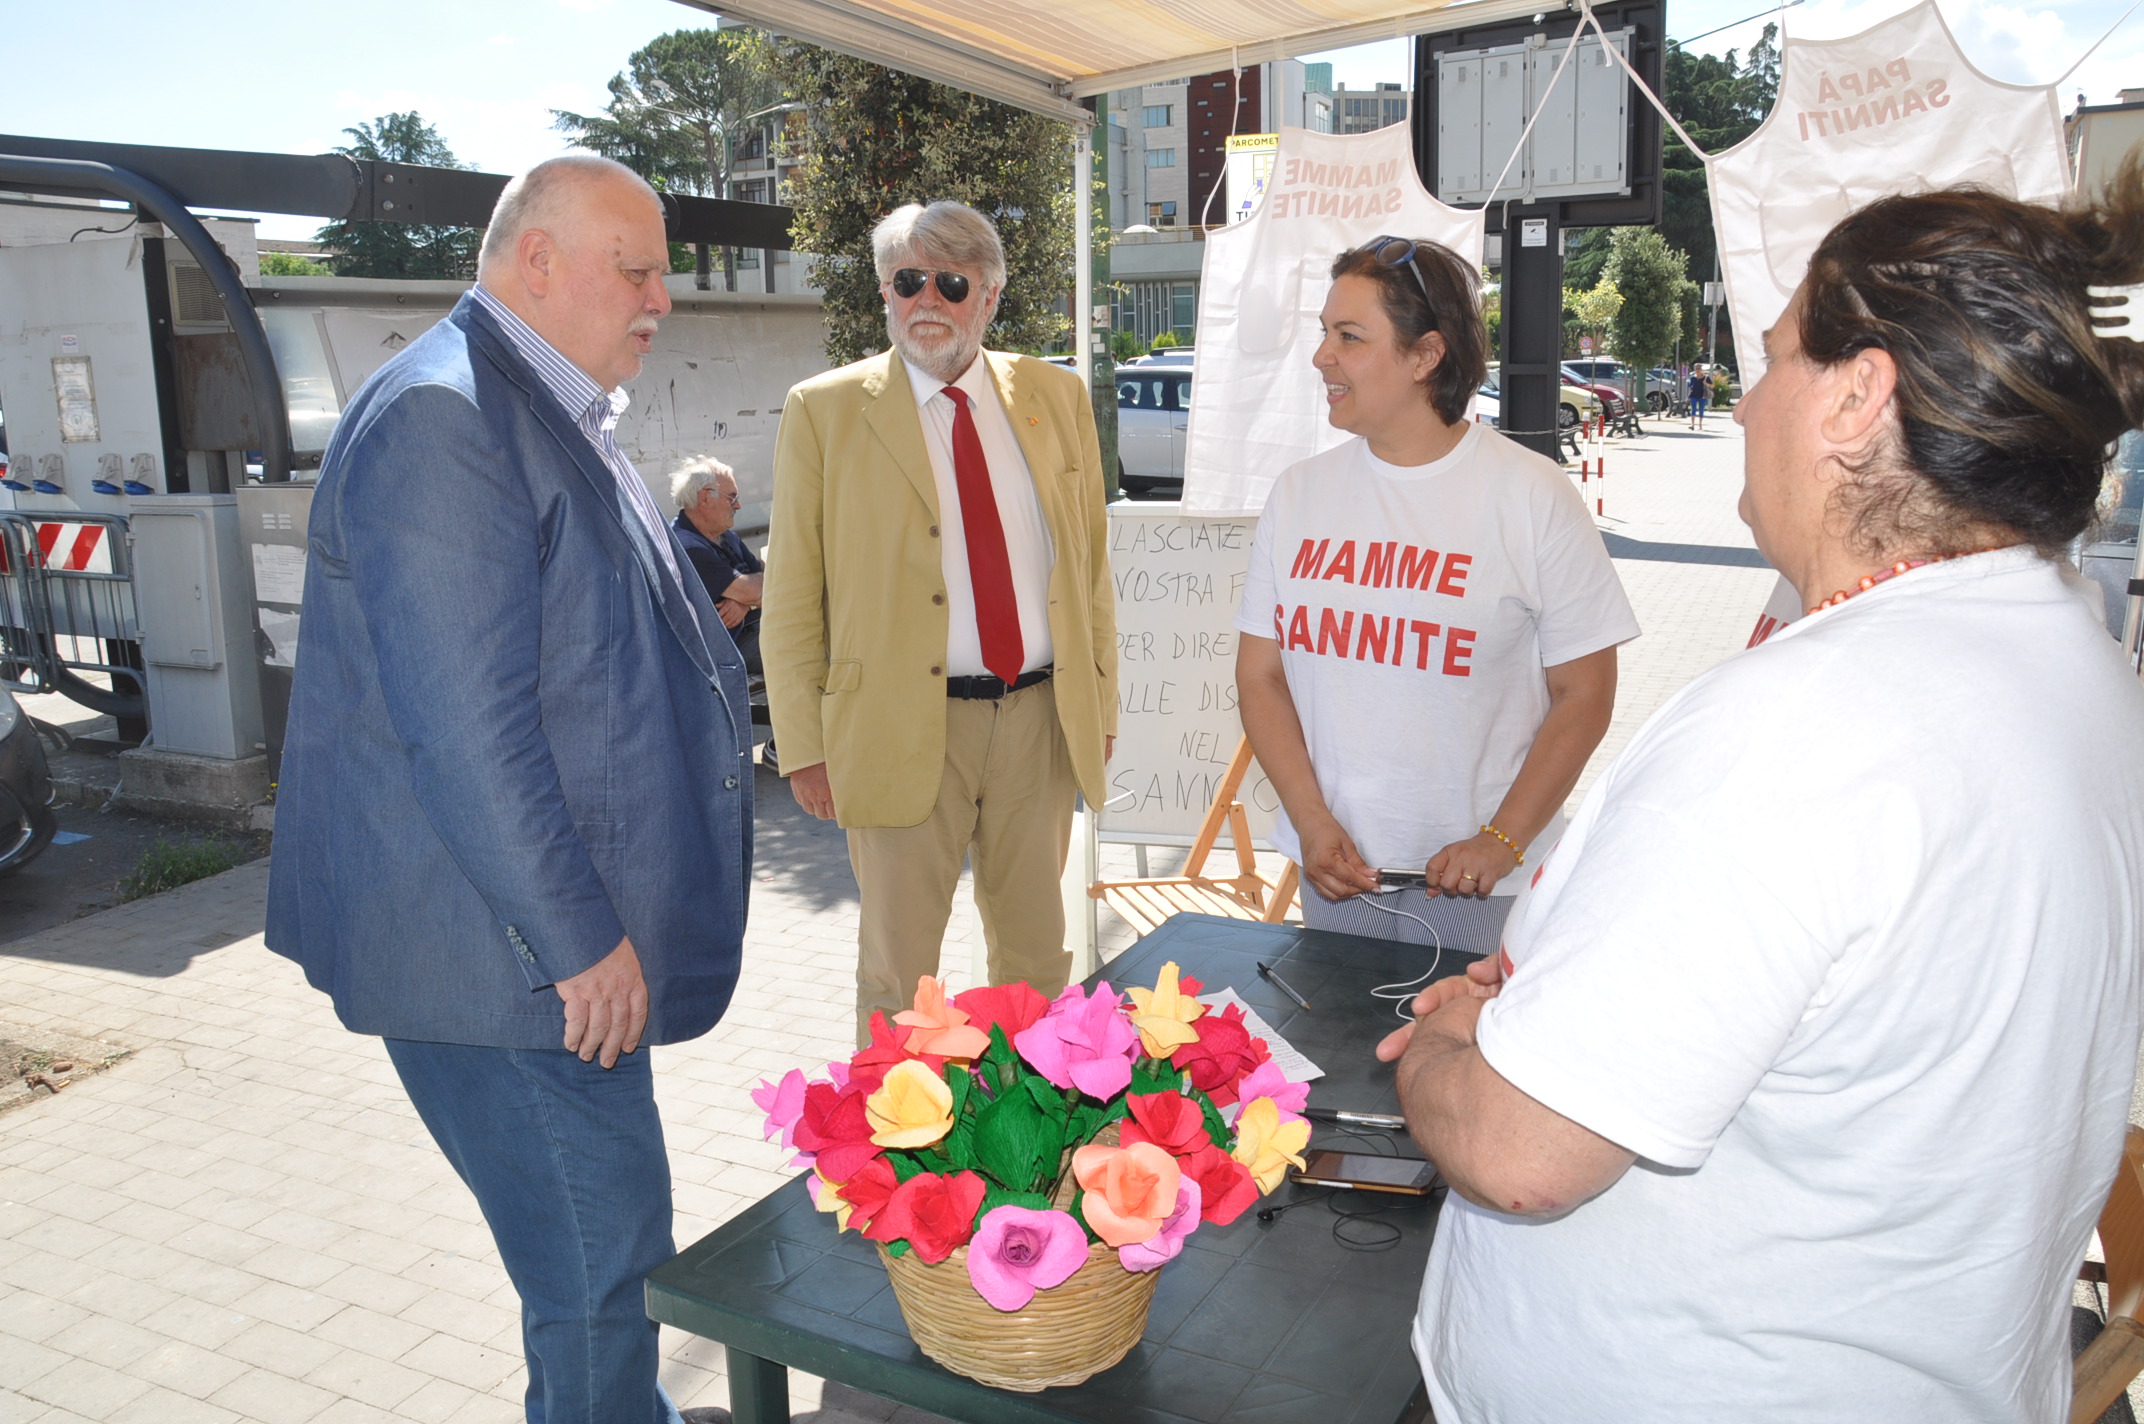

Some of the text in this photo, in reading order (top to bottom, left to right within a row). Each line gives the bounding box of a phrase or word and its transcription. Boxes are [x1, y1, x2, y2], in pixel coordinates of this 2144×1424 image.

[1113, 522, 1246, 553] LASCIATE
[1114, 566, 1214, 606] VOSTRA
[1290, 538, 1472, 598] MAMME
[1172, 631, 1231, 661] DIRE
[1274, 603, 1477, 677] SANNITE
[1198, 681, 1240, 712] DIS
[1179, 729, 1229, 765] NEL
[1111, 769, 1279, 813] SANNO
